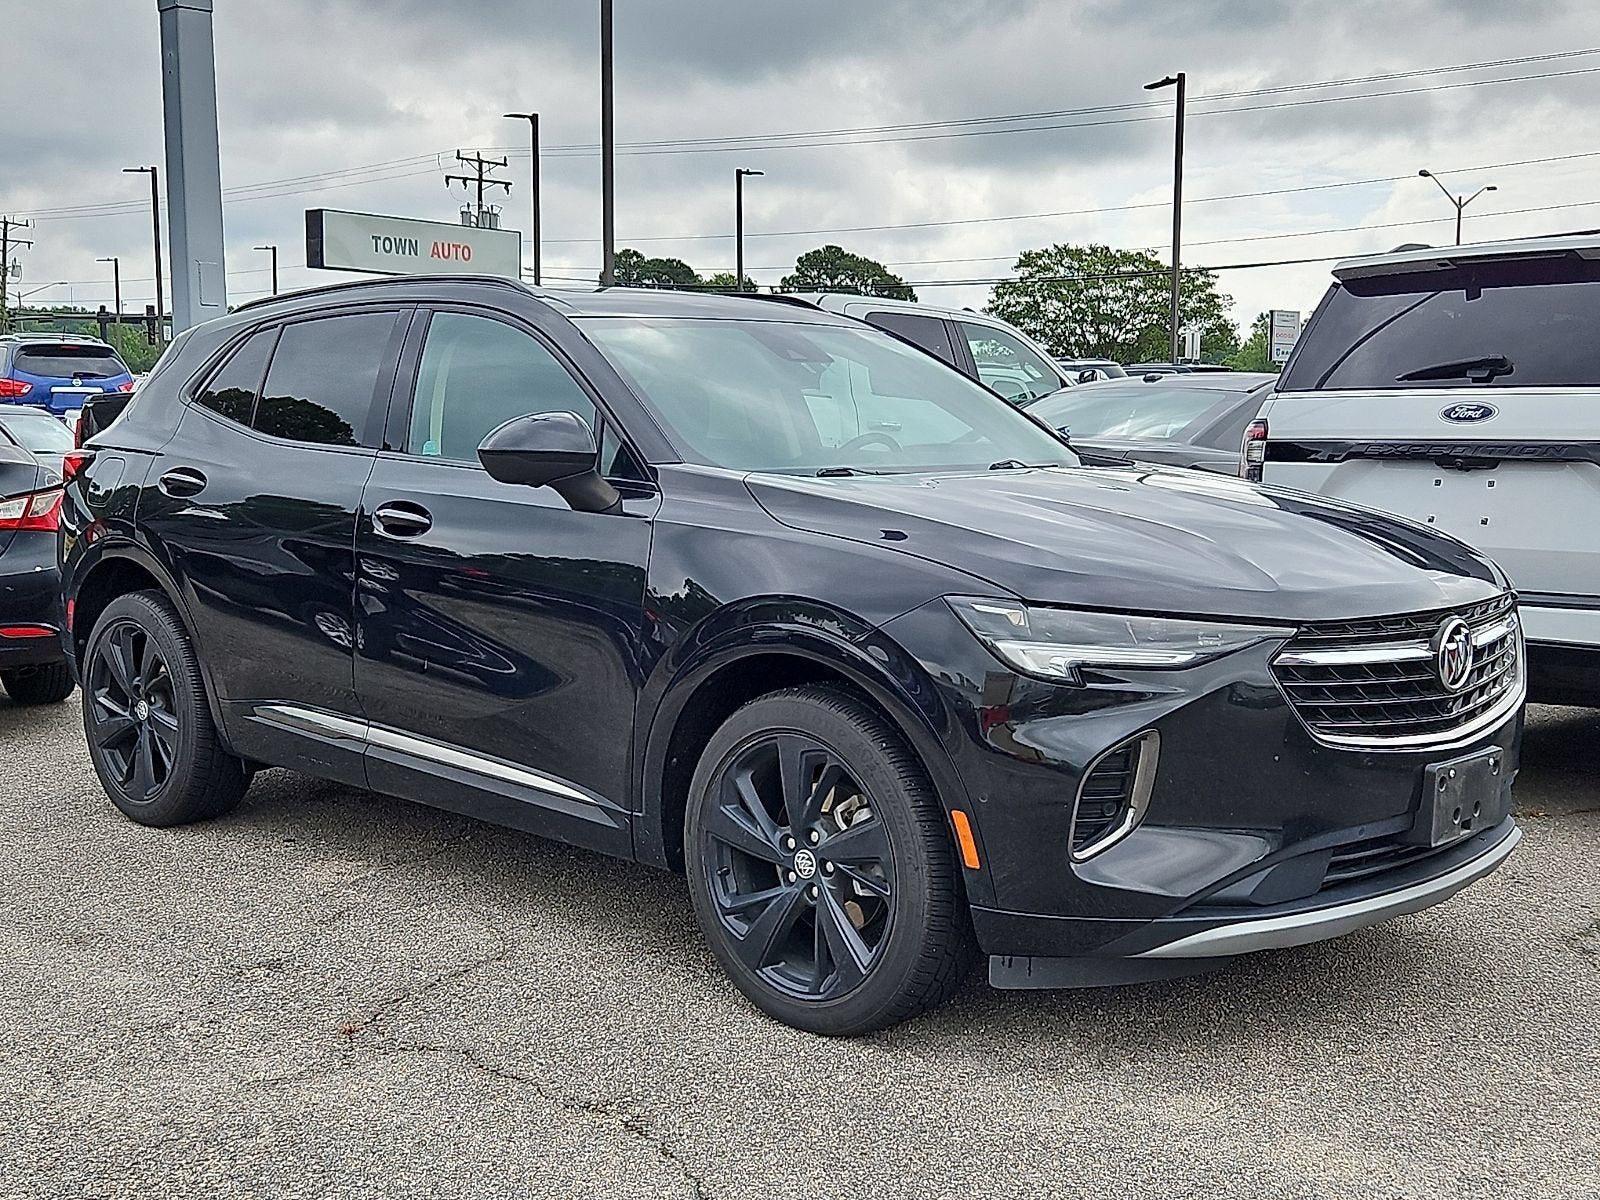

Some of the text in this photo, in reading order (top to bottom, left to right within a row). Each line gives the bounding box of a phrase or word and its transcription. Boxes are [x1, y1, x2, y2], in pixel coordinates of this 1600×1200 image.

[371, 235, 471, 261] TOWN AUTO
[1450, 405, 1483, 419] Ford
[1364, 443, 1568, 457] EXPEDITION
